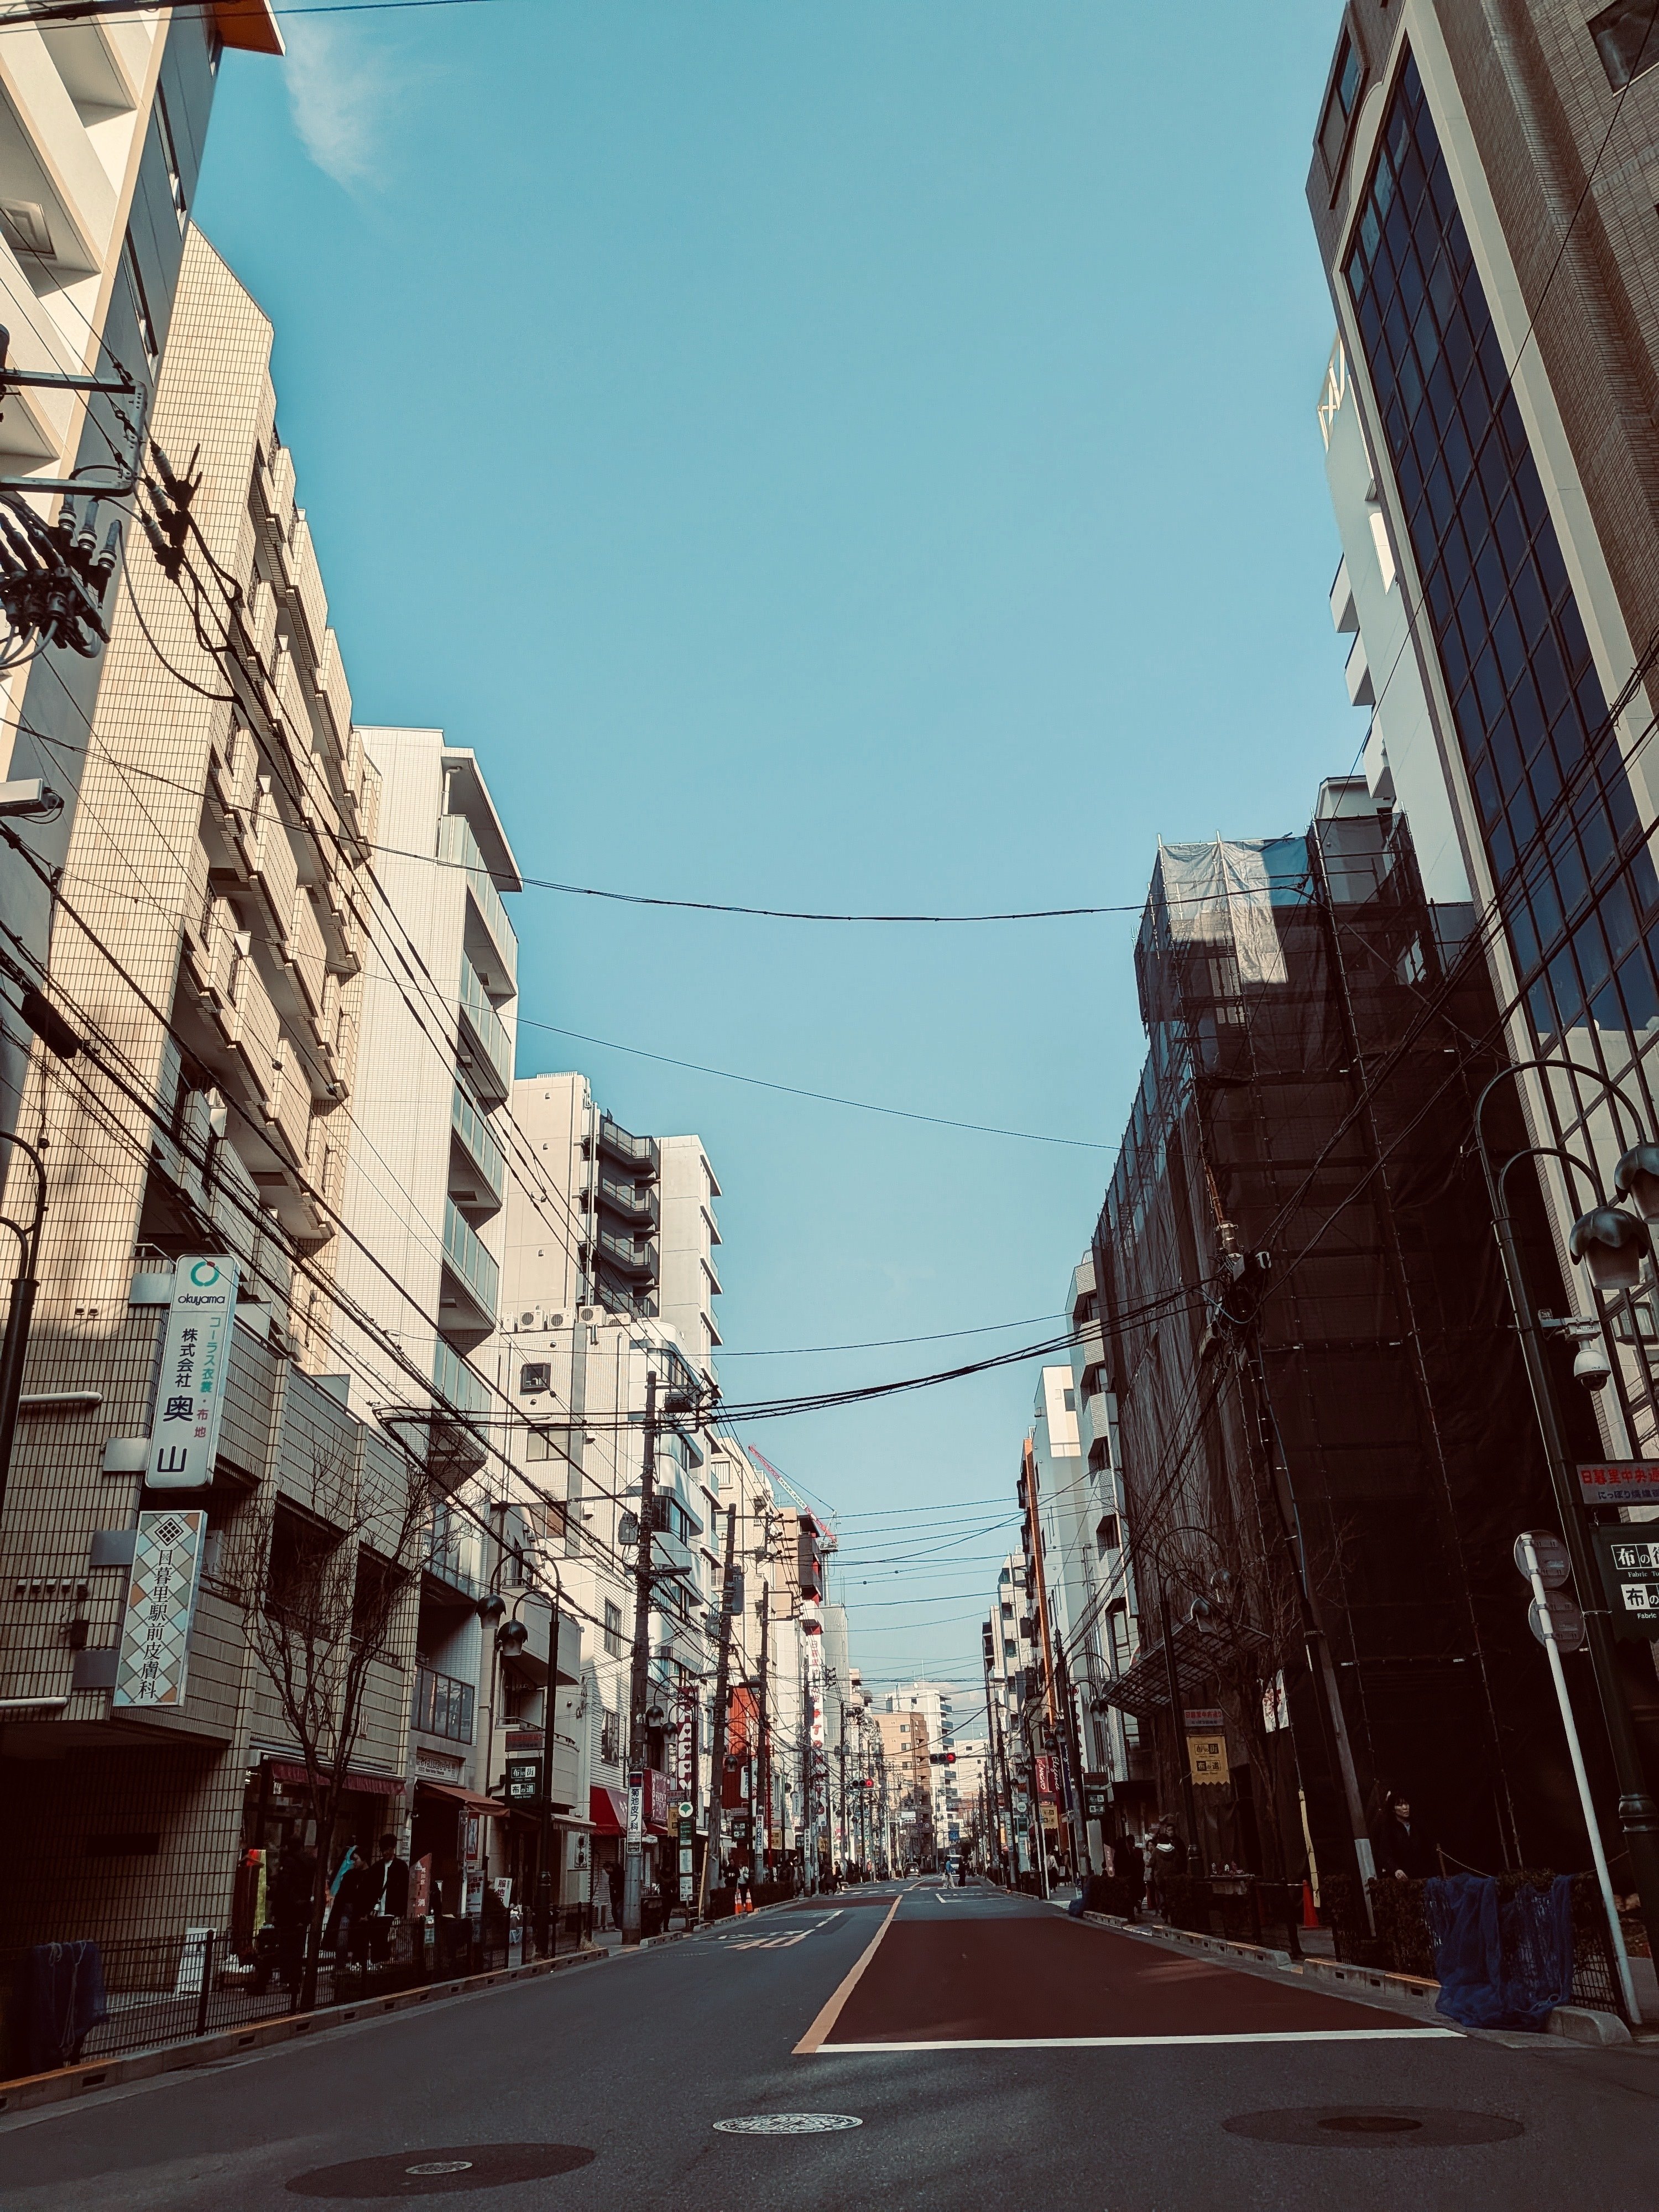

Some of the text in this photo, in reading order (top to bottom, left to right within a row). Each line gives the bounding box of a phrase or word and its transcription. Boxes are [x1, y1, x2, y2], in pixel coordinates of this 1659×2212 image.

[178, 1293, 226, 1306] okuyama
[138, 1549, 173, 1700] 日暮里駅前皮膚科
[630, 1788, 639, 1831] 菊池皮フ科
